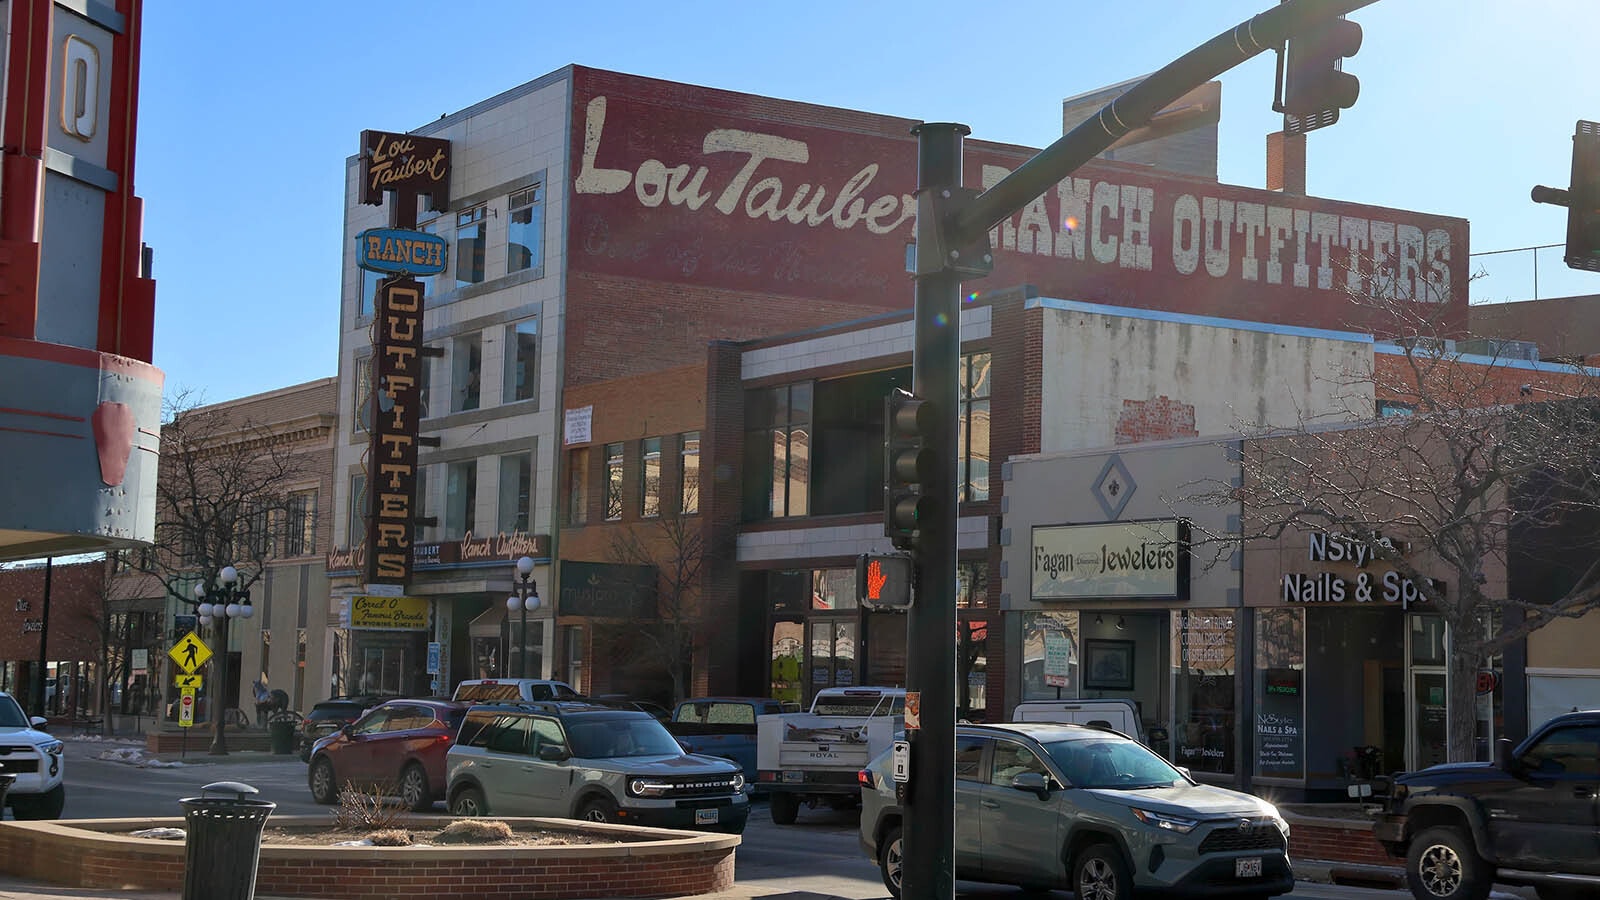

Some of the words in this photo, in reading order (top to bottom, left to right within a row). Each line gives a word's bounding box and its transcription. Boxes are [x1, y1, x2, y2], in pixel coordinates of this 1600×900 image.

[373, 134, 415, 163] Lou
[370, 148, 446, 191] Taubert
[575, 95, 712, 211] Lou
[1172, 194, 1451, 304] OUTFITTERS
[367, 236, 443, 266] RANCH
[377, 286, 420, 579] OUTFITTERS
[460, 530, 491, 560] Ranch
[1034, 546, 1074, 580] Fagan
[1099, 543, 1175, 574] Jewelers
[1284, 572, 1346, 603] Nails
[1355, 572, 1373, 603] &
[355, 597, 387, 610] Corral
[1257, 725, 1277, 734] NAILS
[1284, 725, 1297, 735] SPA
[676, 781, 729, 789] BRONCO
